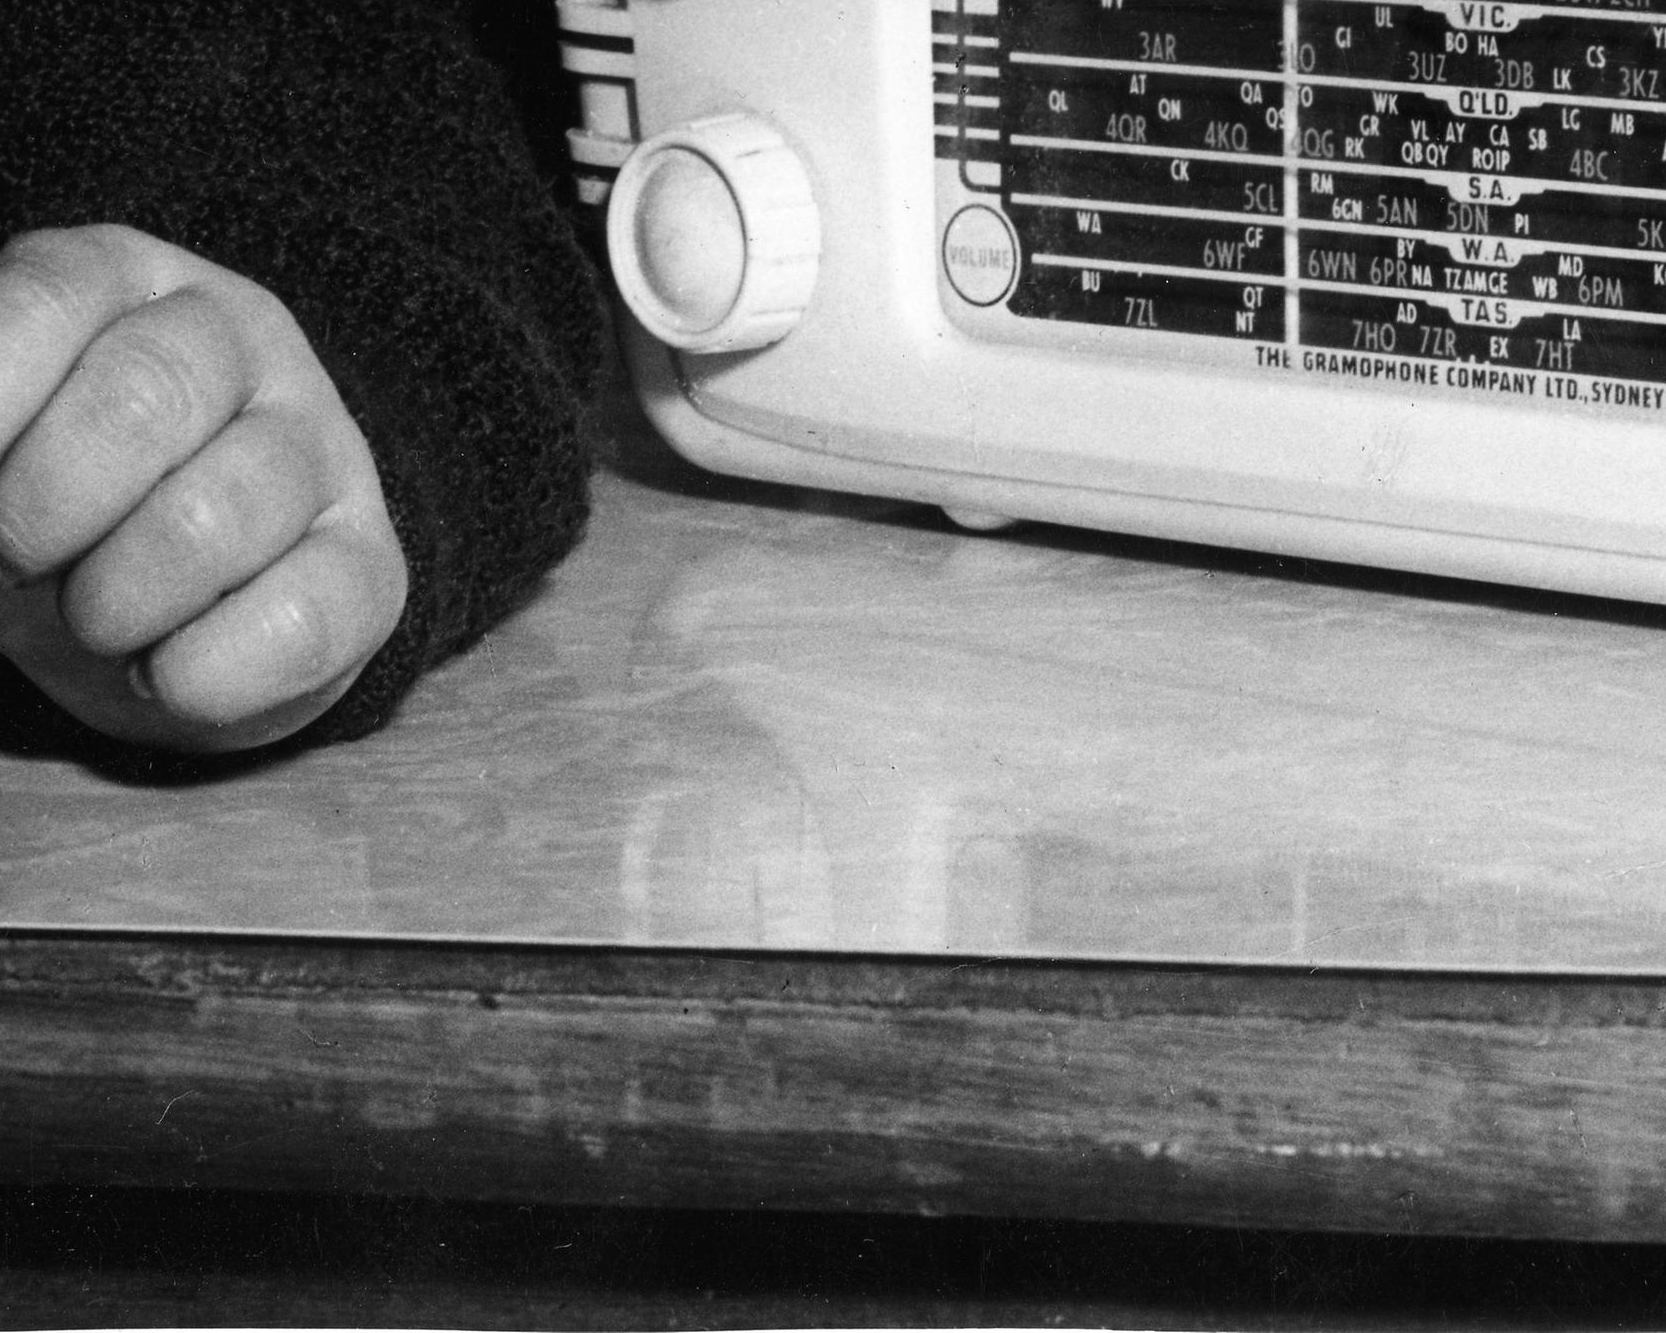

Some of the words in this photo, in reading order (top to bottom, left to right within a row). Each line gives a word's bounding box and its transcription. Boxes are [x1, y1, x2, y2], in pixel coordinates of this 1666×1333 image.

[1375, 5, 1393, 28] UL
[1139, 31, 1176, 62] 3AR
[1445, 32, 1468, 54] BO
[1478, 35, 1499, 57] HA
[1408, 51, 1447, 82] 3UZ
[1586, 46, 1605, 68] CS
[1129, 74, 1147, 94] AT
[1494, 59, 1533, 89] 3DB
[1553, 68, 1571, 90] LK
[1619, 67, 1660, 99] 3KZ
[1049, 90, 1068, 113] QL
[1240, 82, 1262, 104] QA
[1373, 91, 1399, 115] WK
[1158, 98, 1181, 121] QN
[1105, 113, 1147, 143] 4QR
[1411, 119, 1429, 141] VL
[1445, 122, 1466, 143] AY
[1489, 124, 1509, 147] CA
[1611, 112, 1634, 136] MB
[1204, 121, 1249, 152] 4KQ
[1345, 137, 1364, 158] RK
[1528, 128, 1548, 150] SB
[1401, 142, 1423, 165] QB
[1426, 143, 1449, 167] QY
[1569, 149, 1609, 181] 4BC
[1170, 159, 1189, 181] CK
[1311, 173, 1333, 194] RM
[1468, 176, 1512, 201] S.A.
[1243, 182, 1278, 213] 5CL
[1376, 195, 1417, 226] 5AN
[1447, 203, 1488, 233] 5DN
[1076, 211, 1102, 234] WA
[1515, 213, 1529, 234] PI
[948, 244, 1011, 272] VOLUME
[1203, 239, 1246, 270] 6WF
[1397, 238, 1415, 259] BY
[1462, 238, 1515, 263] W.A.
[1308, 249, 1356, 281] 6WN
[1370, 257, 1407, 287] 6PR
[1412, 265, 1433, 287] NA
[1558, 255, 1583, 277] MD
[1243, 286, 1264, 309] QT
[1532, 276, 1558, 299] WB
[1578, 275, 1623, 307] 6PM
[1124, 297, 1158, 328] 7ZL
[1236, 311, 1255, 333] NT
[1396, 302, 1417, 324] AD
[1461, 298, 1513, 325] TAS.
[1352, 320, 1396, 352] 7HO
[1420, 325, 1456, 357] 7ZR
[1562, 318, 1582, 341] LA
[1490, 336, 1509, 358] EX
[1536, 339, 1574, 371] 7HT
[1255, 346, 1291, 369] THE
[1303, 351, 1439, 386] GRAMOPHONE
[1446, 367, 1537, 395] COMPANY
